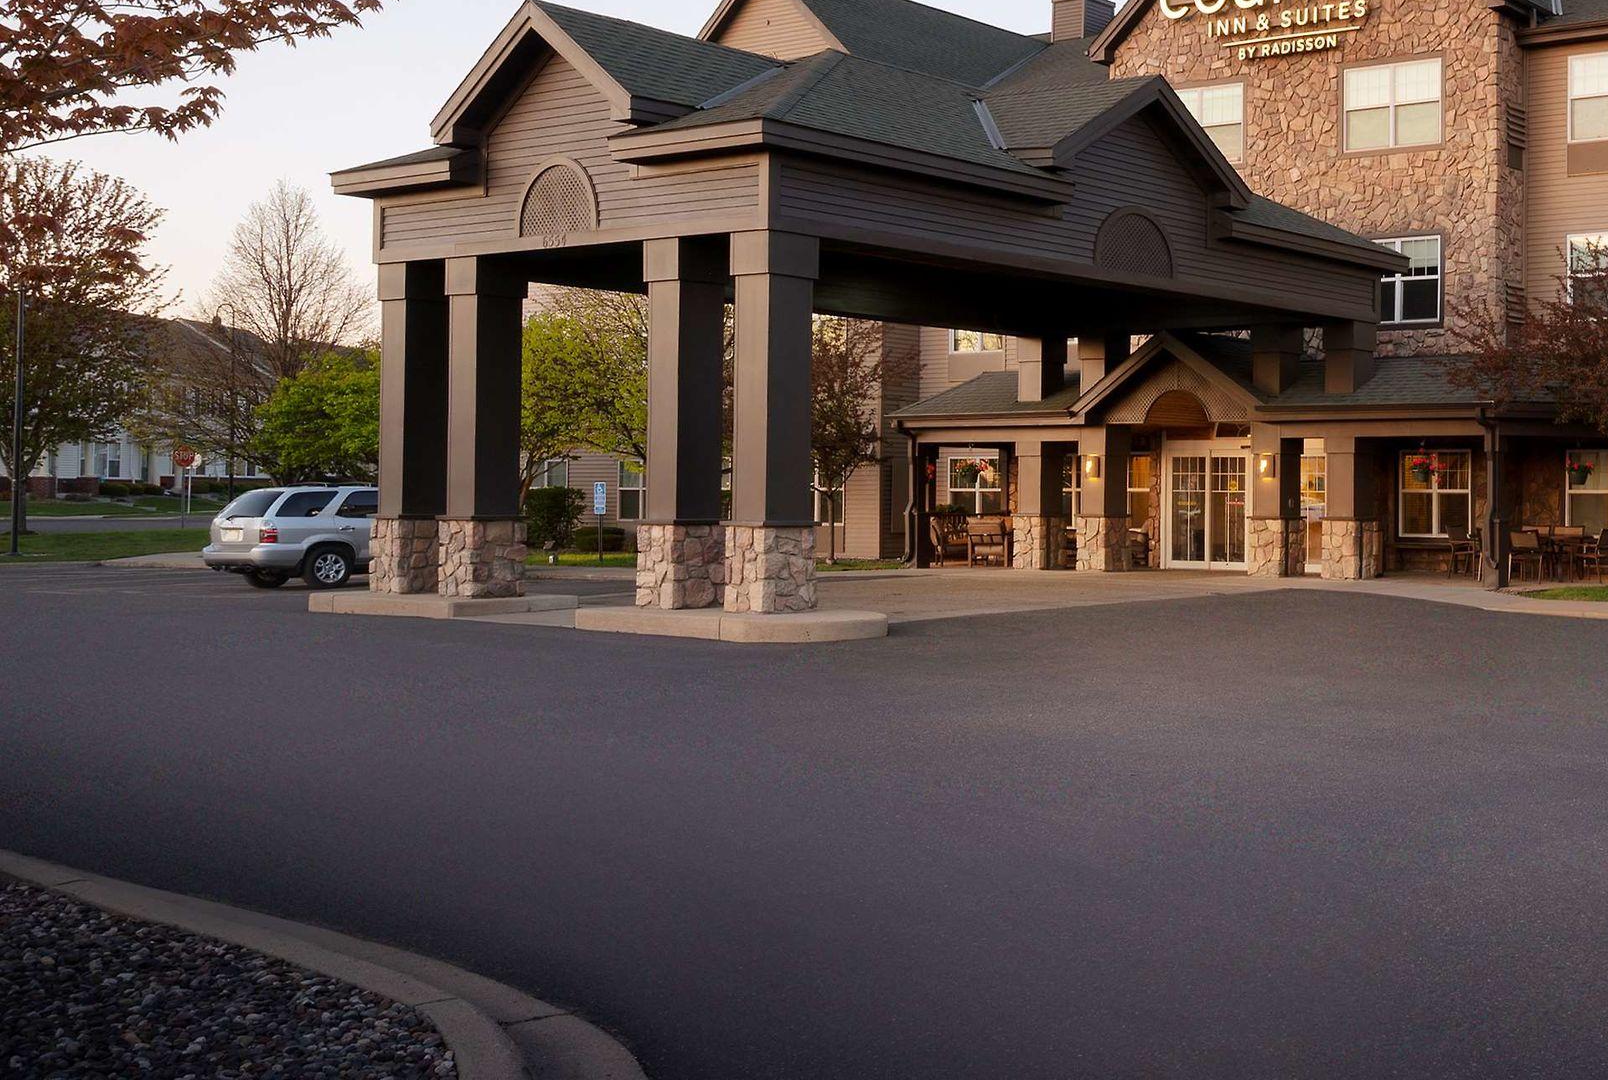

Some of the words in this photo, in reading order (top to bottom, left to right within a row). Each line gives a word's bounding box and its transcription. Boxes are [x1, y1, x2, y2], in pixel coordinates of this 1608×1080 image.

[1207, 16, 1247, 38] INN
[1256, 13, 1270, 31] &
[1280, 0, 1367, 28] SUITES
[1238, 46, 1256, 61] BY
[1261, 34, 1337, 58] RADISSON
[174, 450, 194, 461] STOP
